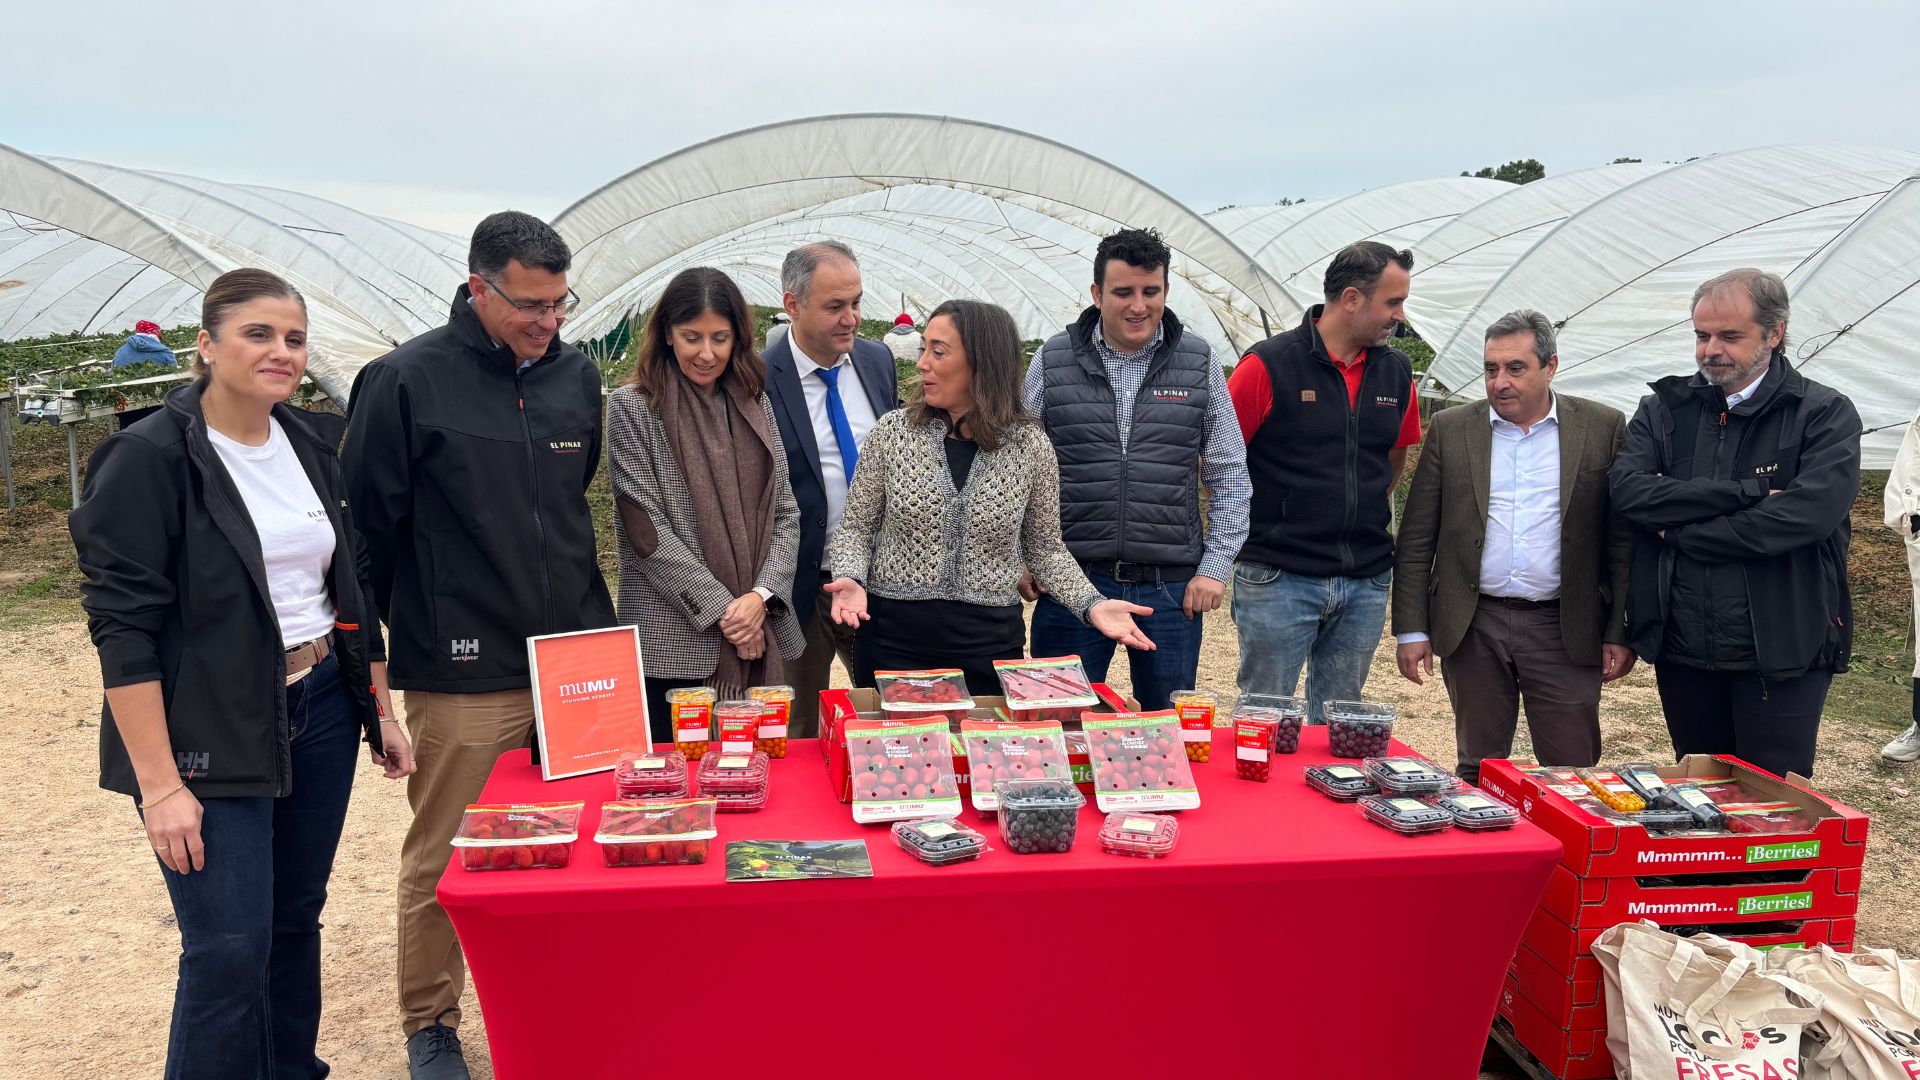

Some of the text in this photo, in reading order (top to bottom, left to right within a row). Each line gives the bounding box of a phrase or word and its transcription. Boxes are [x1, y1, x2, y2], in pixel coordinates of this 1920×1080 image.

[1163, 389, 1188, 397] PINAR
[451, 638, 480, 654] HH
[1747, 843, 1818, 863] ¡Berries!
[1739, 895, 1811, 915] ¡Berries!
